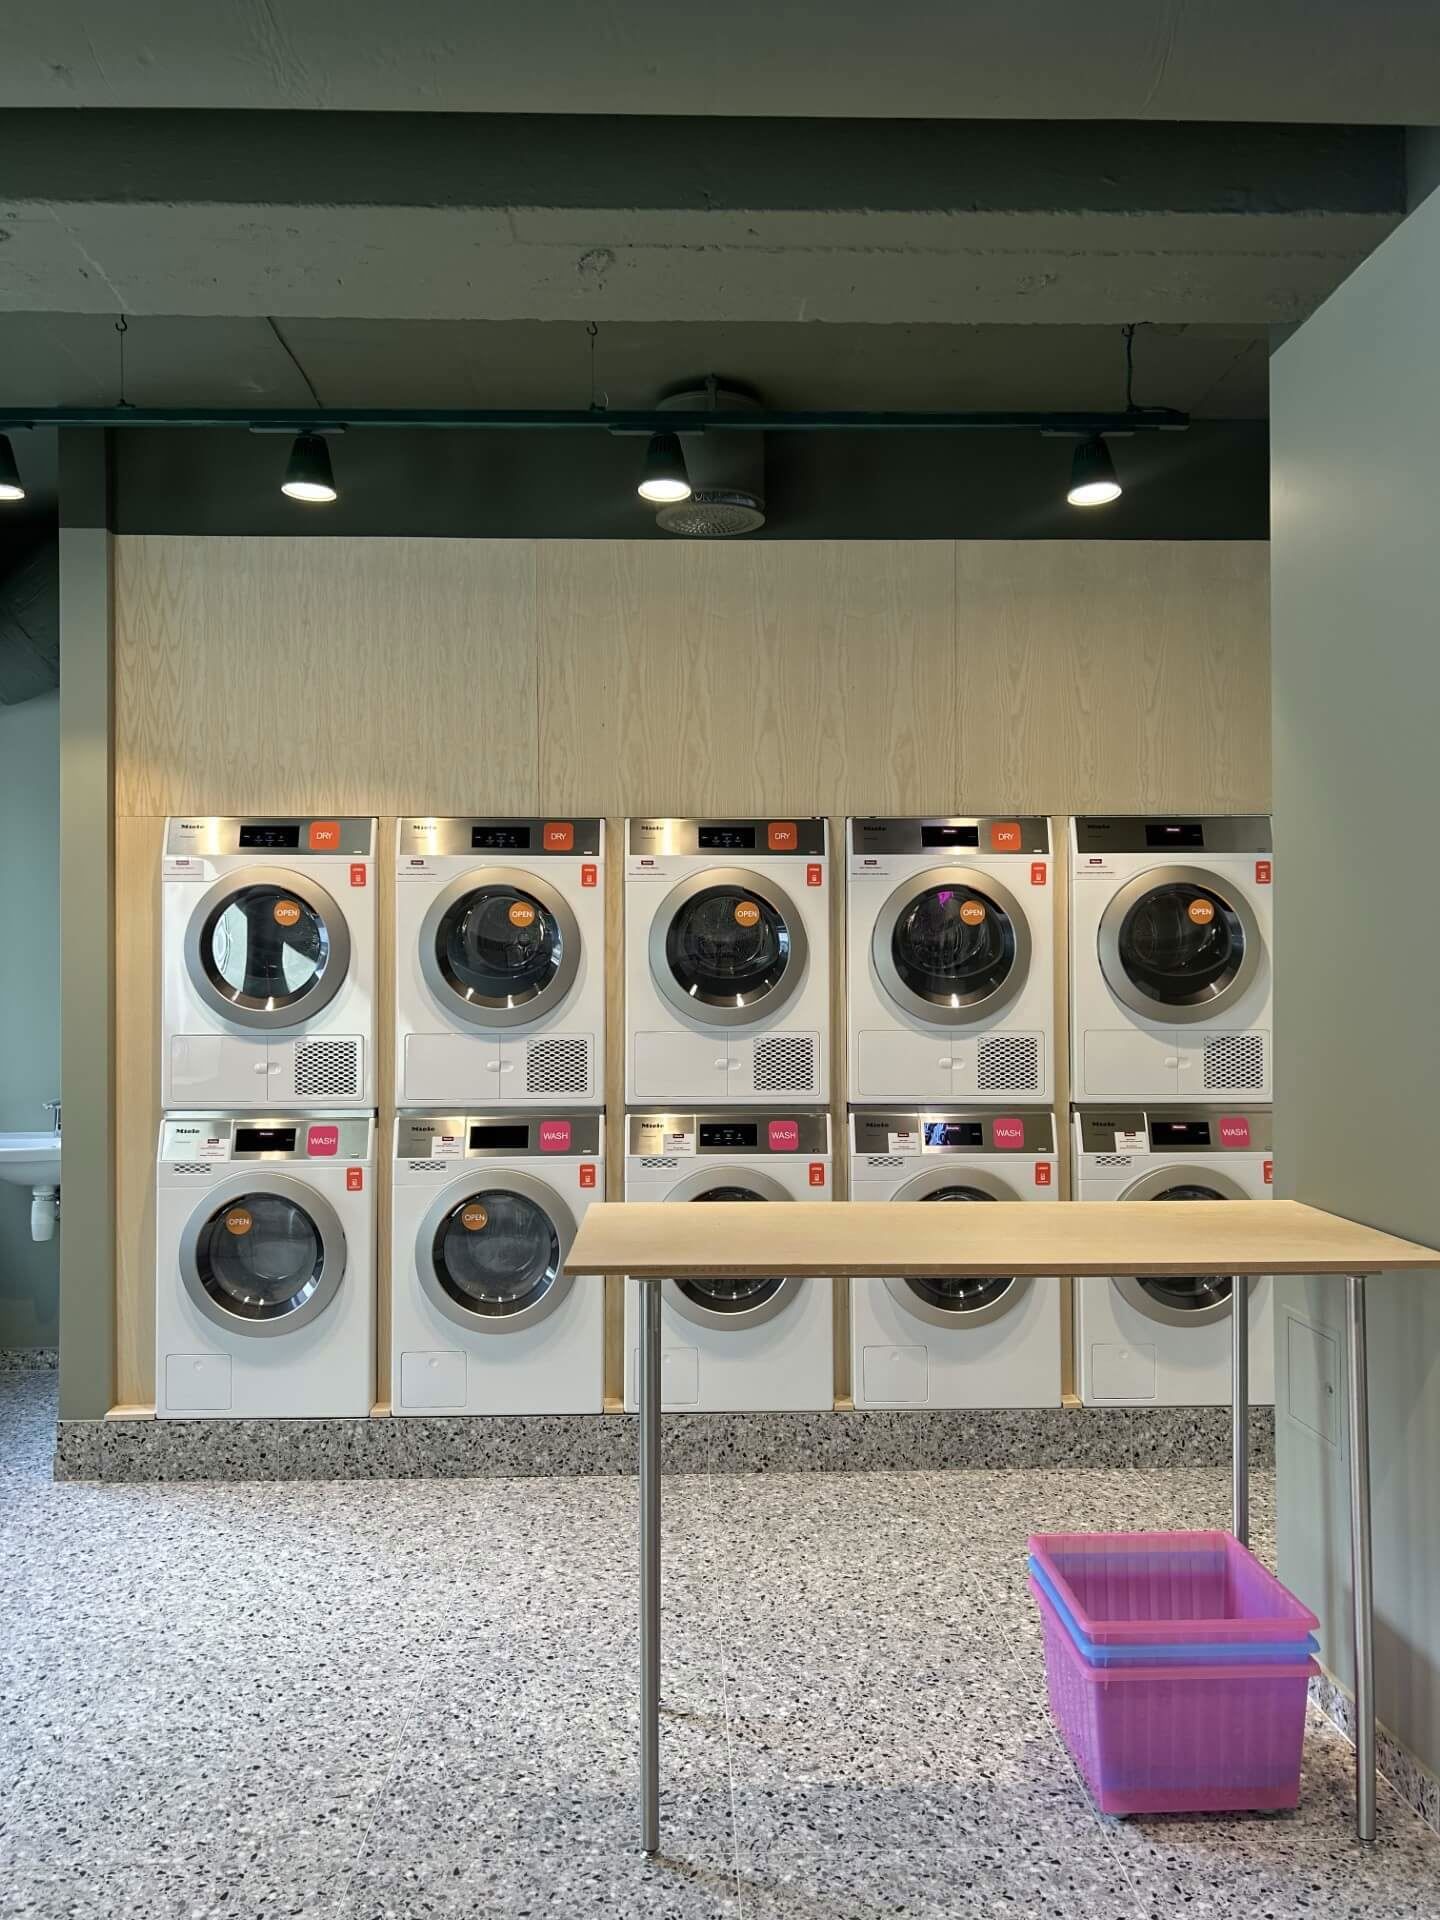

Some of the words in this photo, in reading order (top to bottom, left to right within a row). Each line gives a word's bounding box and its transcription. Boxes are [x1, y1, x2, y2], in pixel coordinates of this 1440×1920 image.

[316, 831, 333, 840] DRY
[551, 832, 567, 840] DRY
[774, 832, 791, 840] DRY
[998, 832, 1014, 840] DRY
[277, 909, 298, 917] OPEN
[512, 910, 534, 918] OPEN
[737, 910, 758, 918] OPEN
[962, 909, 983, 917] OPEN
[1191, 907, 1212, 915] OPEN
[543, 1132, 568, 1140] WASH
[771, 1131, 796, 1139] WASH
[996, 1129, 1021, 1137] WASH
[1222, 1128, 1248, 1136] WASH
[310, 1137, 336, 1145] WASH
[228, 1218, 249, 1226] OPEN
[464, 1214, 485, 1222] OPEN
